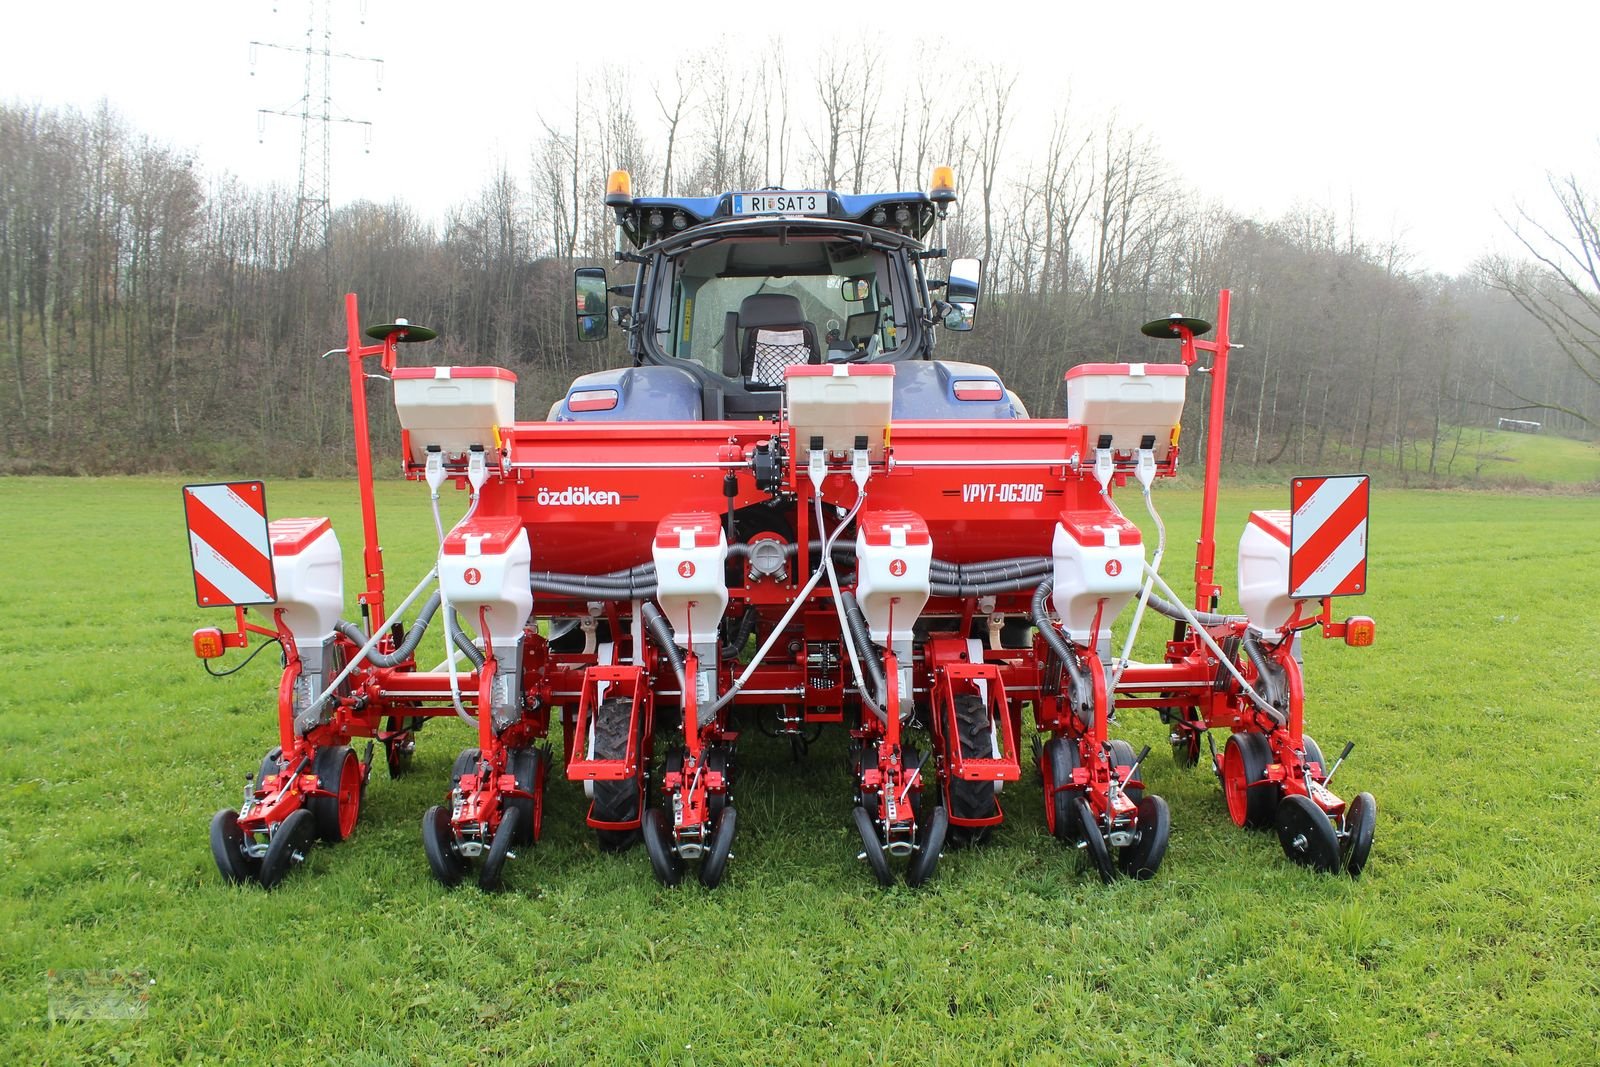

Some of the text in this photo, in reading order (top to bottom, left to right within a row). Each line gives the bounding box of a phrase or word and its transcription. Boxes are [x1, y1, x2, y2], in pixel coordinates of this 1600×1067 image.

[752, 196, 816, 211] RI SAT 3
[537, 486, 620, 506] özdöken
[962, 483, 1044, 503] VPYT-DG306
